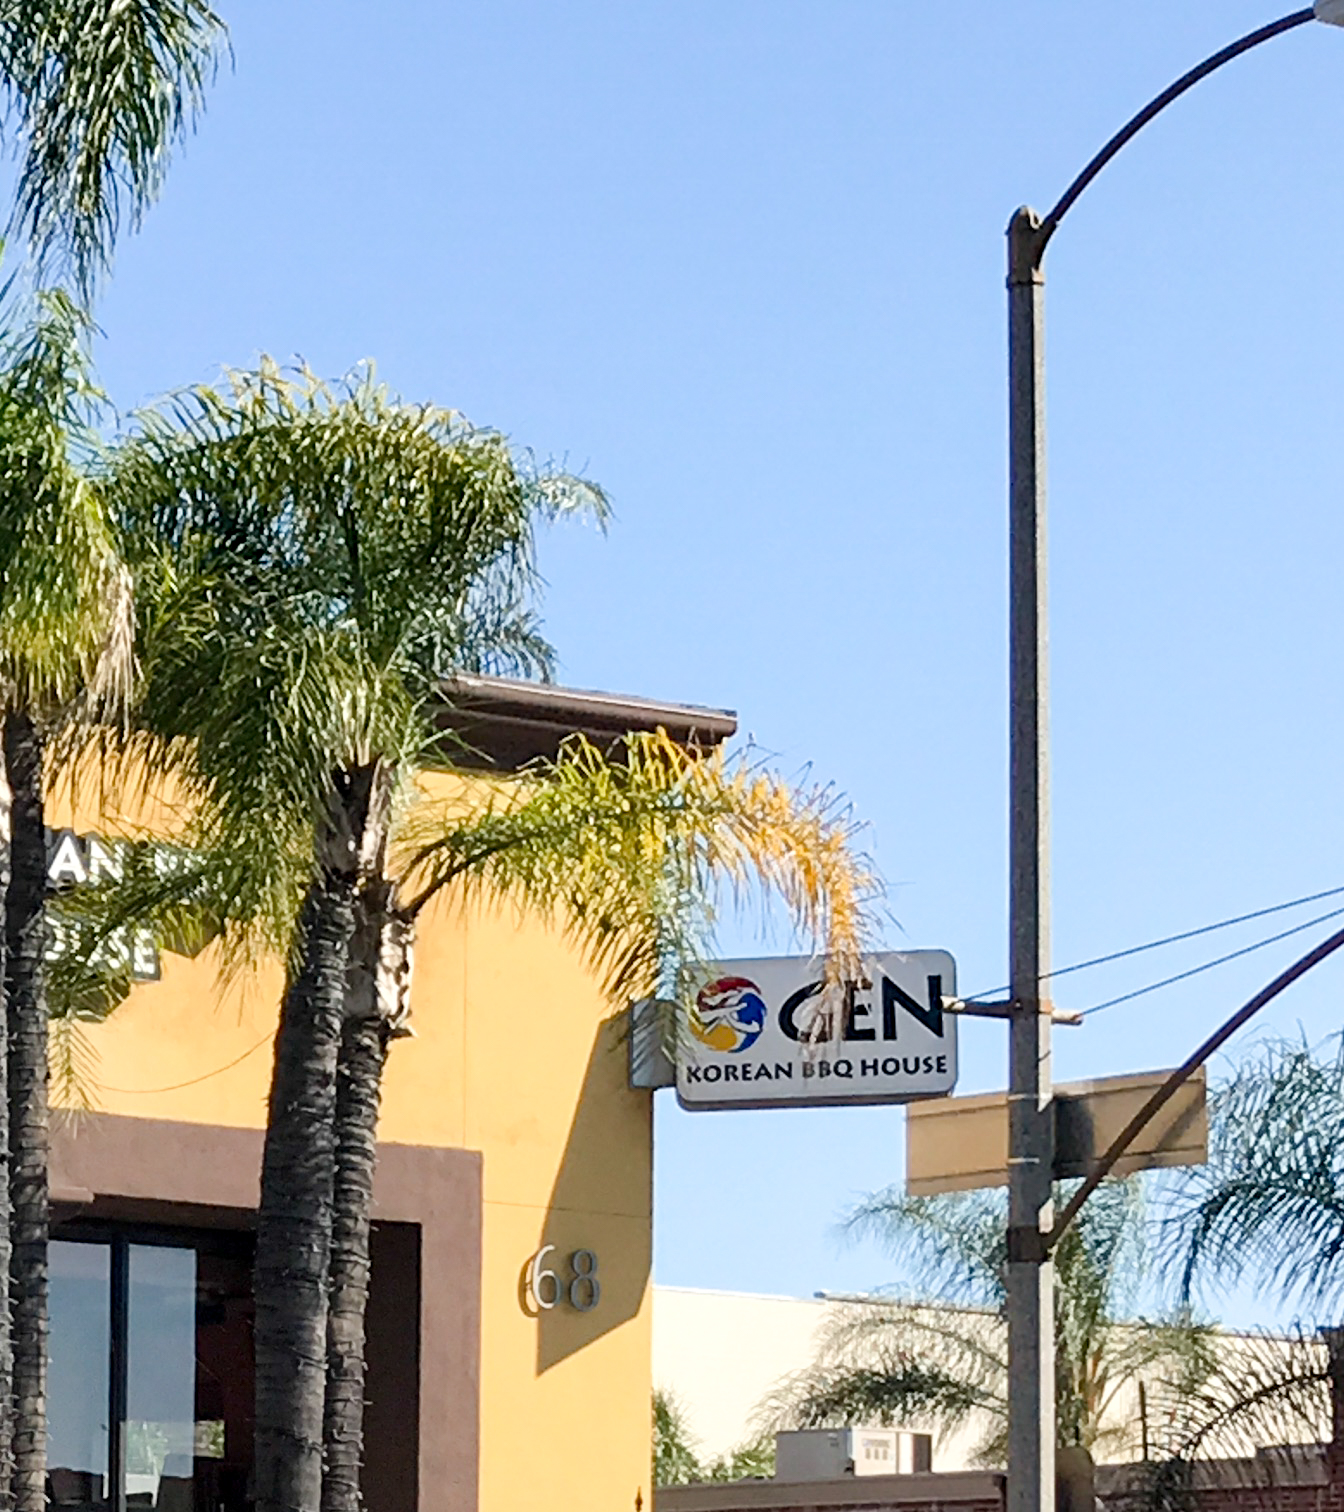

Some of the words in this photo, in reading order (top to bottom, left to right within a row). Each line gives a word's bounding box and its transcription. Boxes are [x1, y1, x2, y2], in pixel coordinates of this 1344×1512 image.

[686, 1061, 793, 1084] KOREAN
[802, 1059, 854, 1079] BBQ
[861, 1055, 948, 1077] HOUSE
[532, 1244, 601, 1313] 68
